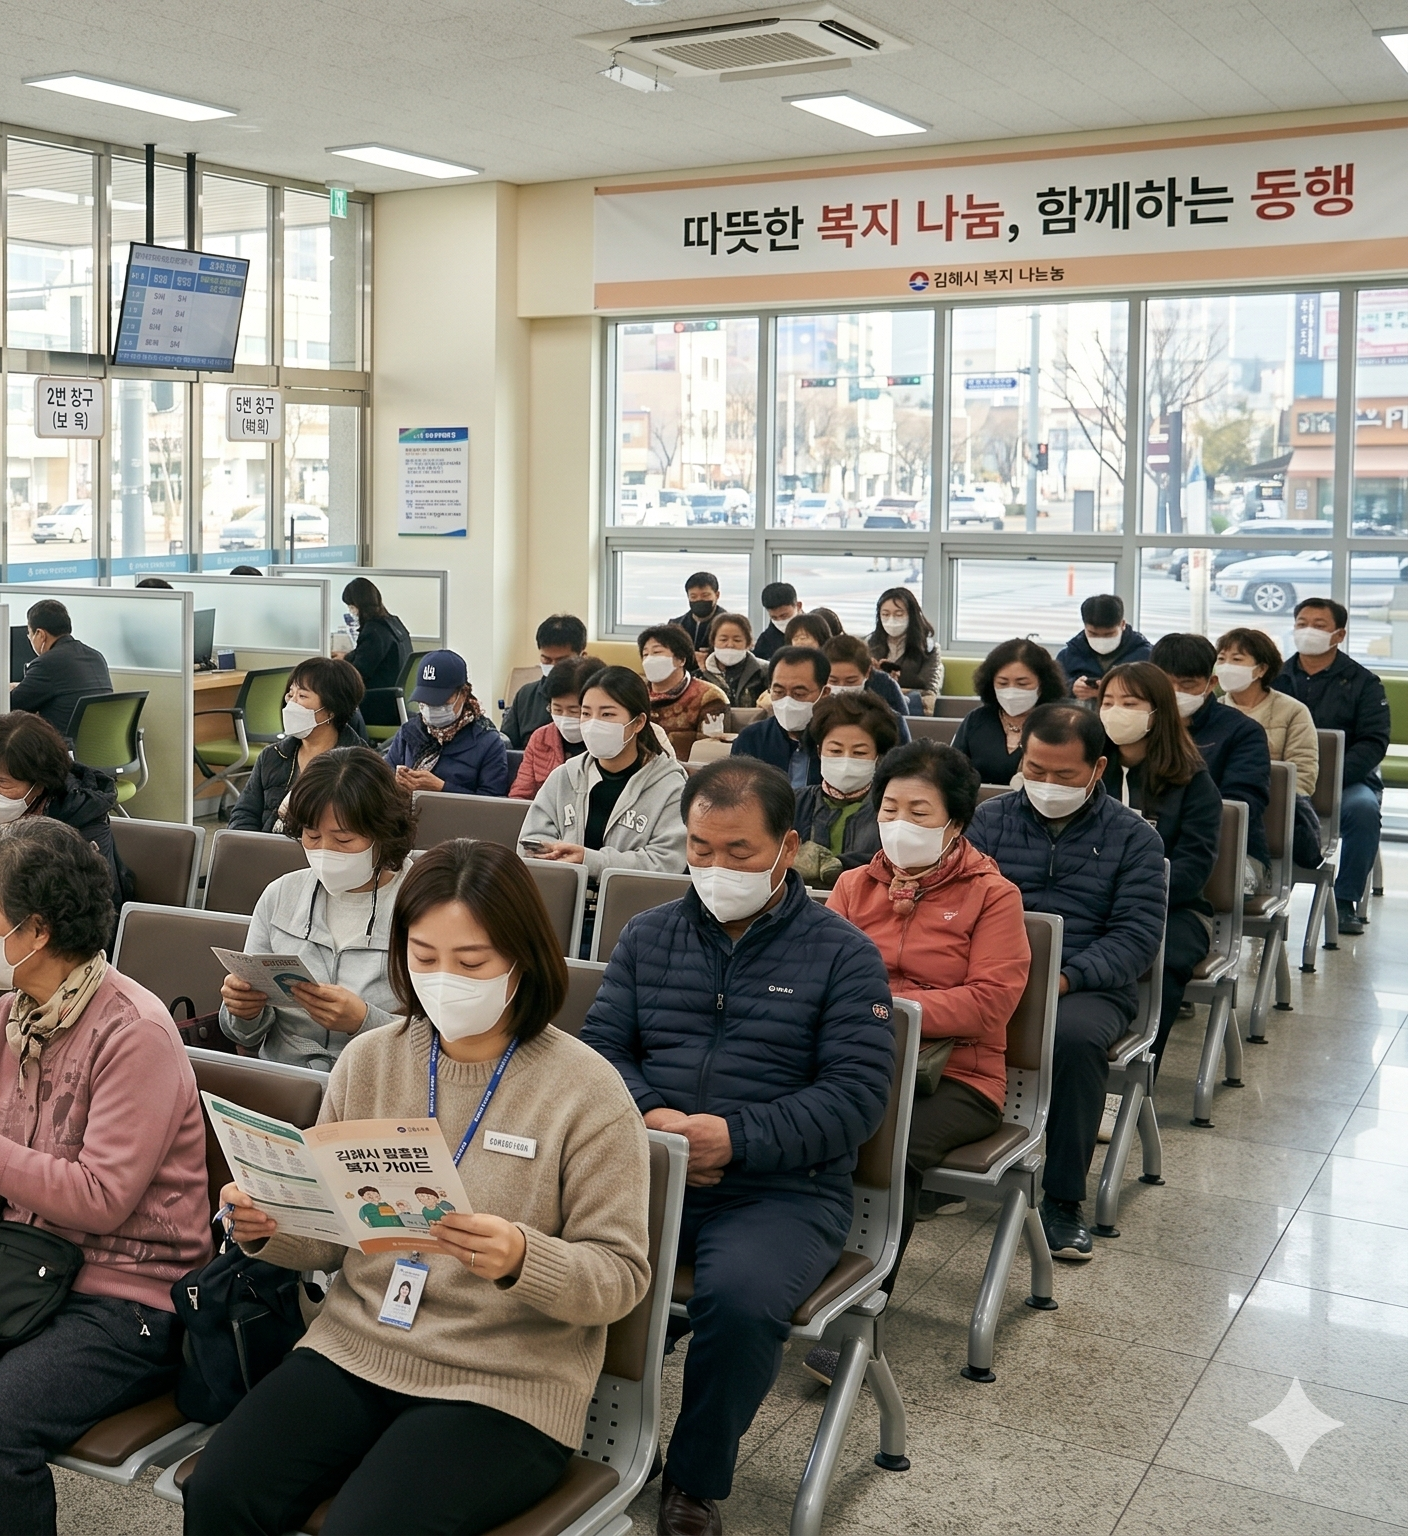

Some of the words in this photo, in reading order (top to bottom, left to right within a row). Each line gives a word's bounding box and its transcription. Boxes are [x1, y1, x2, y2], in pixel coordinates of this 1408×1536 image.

[682, 205, 804, 256] 따뜻한
[817, 199, 900, 250] 복지
[916, 193, 1022, 244] 나눔,
[1035, 175, 1235, 236] 함께하는
[1250, 162, 1357, 219] 동행
[934, 270, 978, 289] 김해시
[983, 268, 1013, 285] 복지
[47, 386, 67, 407] 2번
[70, 387, 94, 408] 창구
[52, 410, 68, 430] (보
[382, 1161, 434, 1174] 가이드
